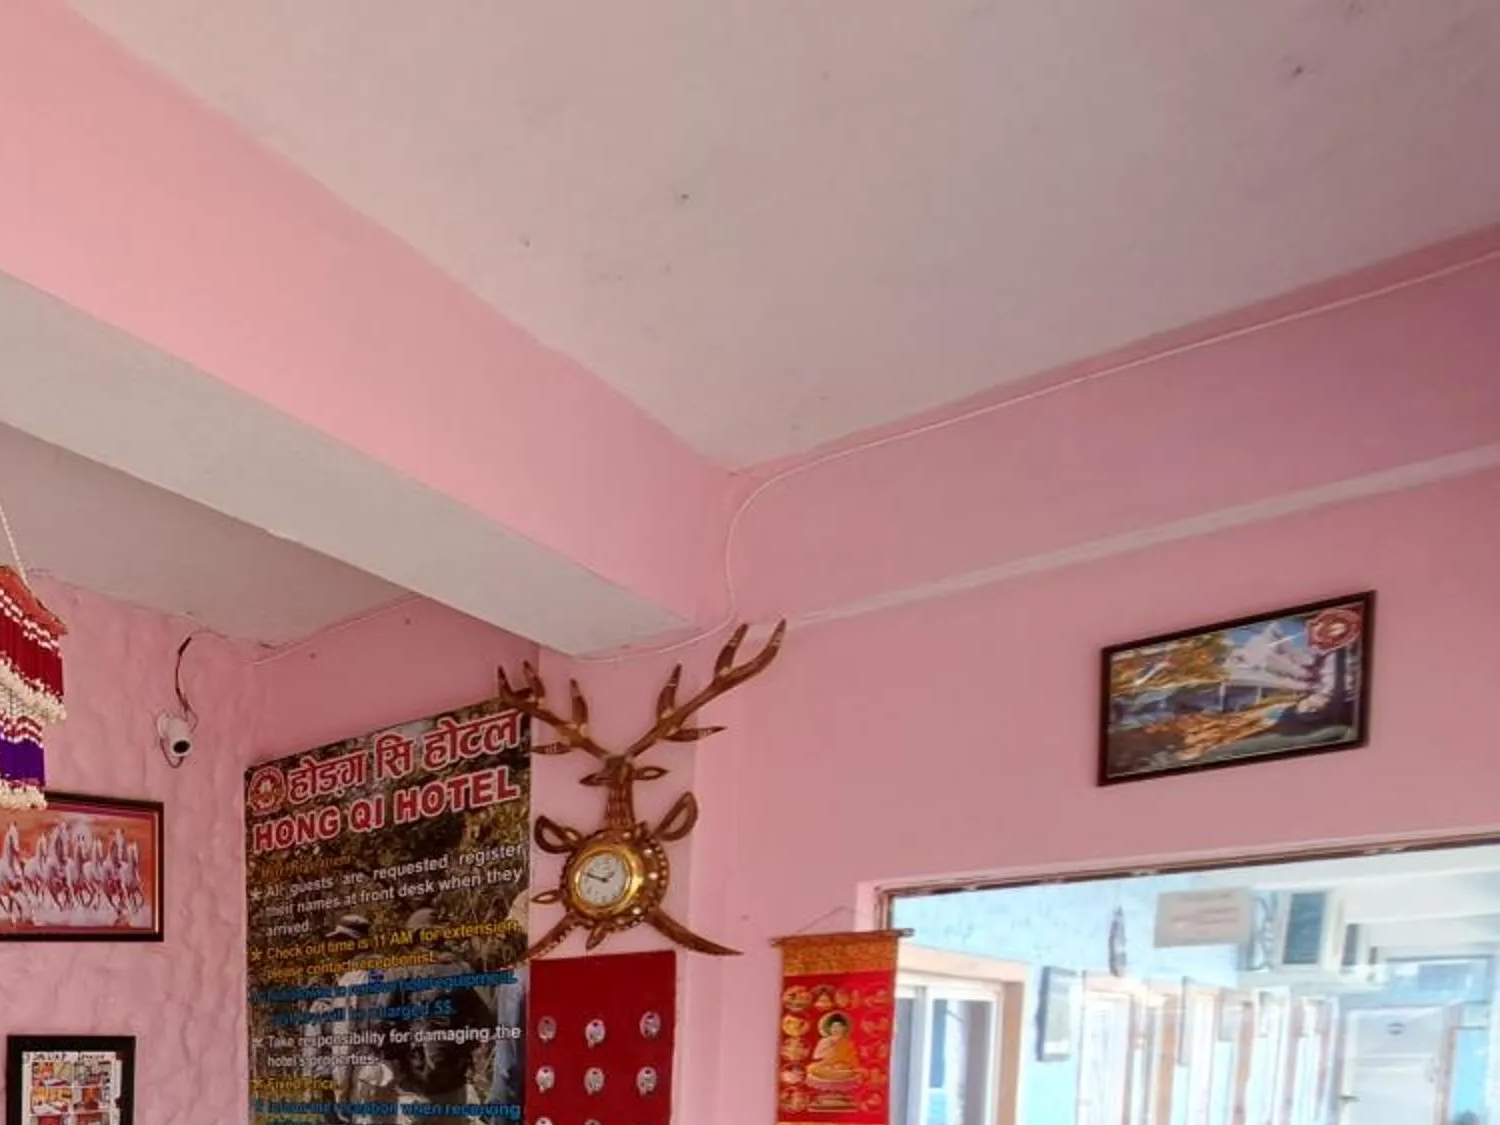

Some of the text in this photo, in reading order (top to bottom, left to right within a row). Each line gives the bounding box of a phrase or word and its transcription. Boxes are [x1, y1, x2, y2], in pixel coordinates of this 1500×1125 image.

[253, 765, 520, 852] HONG QI HOTEL
[373, 854, 448, 883] requested
[459, 841, 522, 870] register
[359, 886, 394, 903] front
[397, 880, 434, 897] desk
[438, 873, 481, 891] when
[486, 867, 521, 888] they
[389, 1030, 410, 1043] for
[414, 1026, 490, 1045] damaging
[495, 1025, 520, 1039] the
